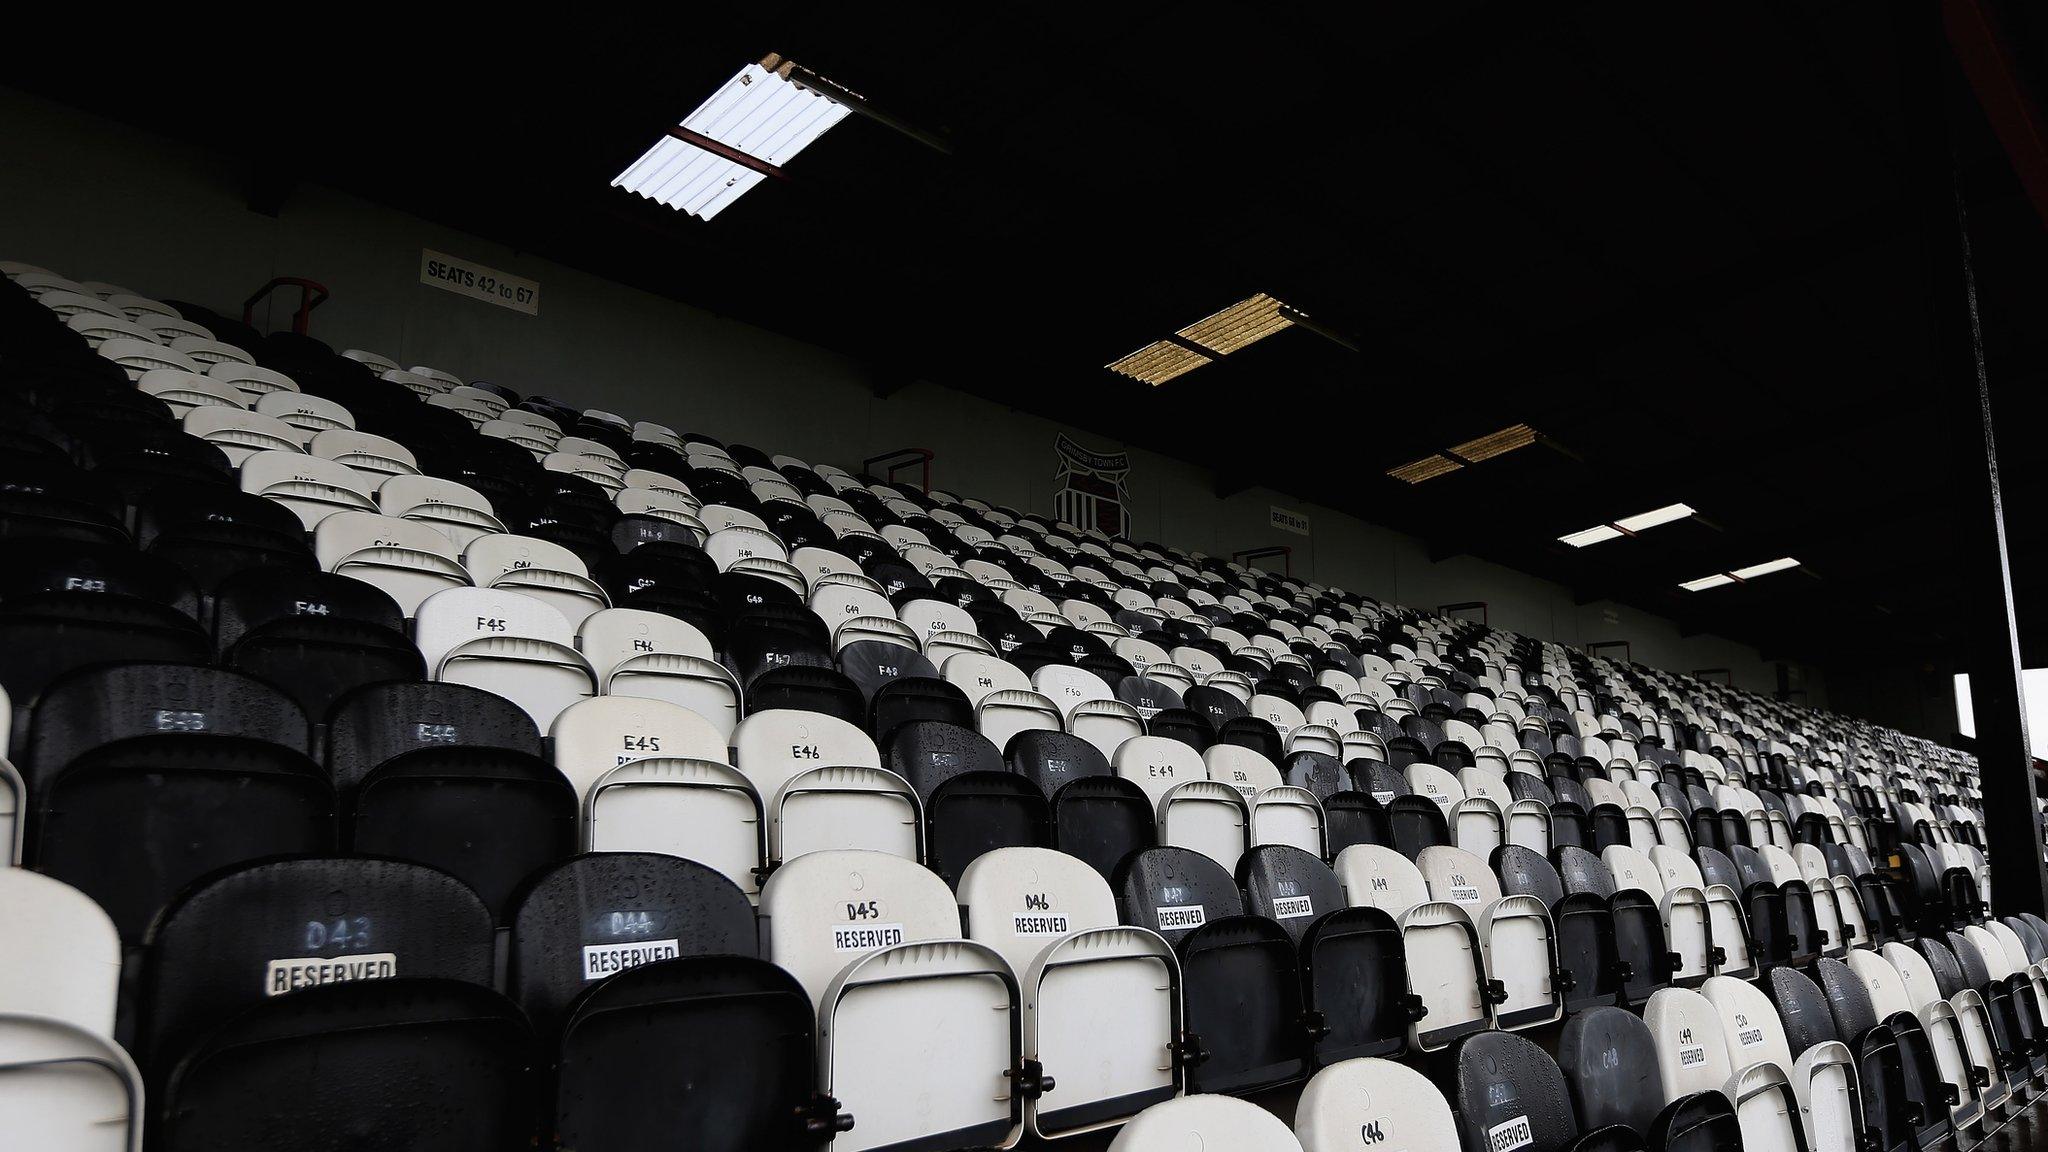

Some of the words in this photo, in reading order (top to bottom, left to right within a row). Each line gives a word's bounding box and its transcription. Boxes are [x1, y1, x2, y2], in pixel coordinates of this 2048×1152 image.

[428, 261, 474, 287] SEATS
[478, 276, 496, 294] 42
[500, 283, 512, 299] to
[517, 287, 534, 304] 67
[1061, 441, 1092, 463] GRIMSBY
[1093, 457, 1114, 468] TOWN
[845, 604, 859, 615] G49
[476, 617, 506, 633] F45
[931, 621, 946, 631] G50
[634, 640, 653, 652] F46
[878, 665, 898, 677] F48
[978, 677, 993, 688] F49
[1140, 698, 1155, 708] F51
[1208, 705, 1224, 715] F52
[624, 735, 660, 752] E45
[792, 745, 820, 760] E46
[1371, 877, 1388, 891] D49
[1025, 893, 1049, 910] D46
[1275, 900, 1311, 916] RESERVED
[847, 902, 879, 920] D45
[1160, 909, 1203, 927] RESERVED
[611, 910, 653, 935] D44
[1015, 917, 1068, 934] RESERVED
[305, 917, 370, 949] D43
[836, 927, 902, 949] RESERVED
[1739, 1029, 1763, 1046] RESERVED
[1680, 1047, 1705, 1066] RESERVED
[1361, 1120, 1385, 1145] C46
[1491, 1122, 1531, 1152] RESERVED
